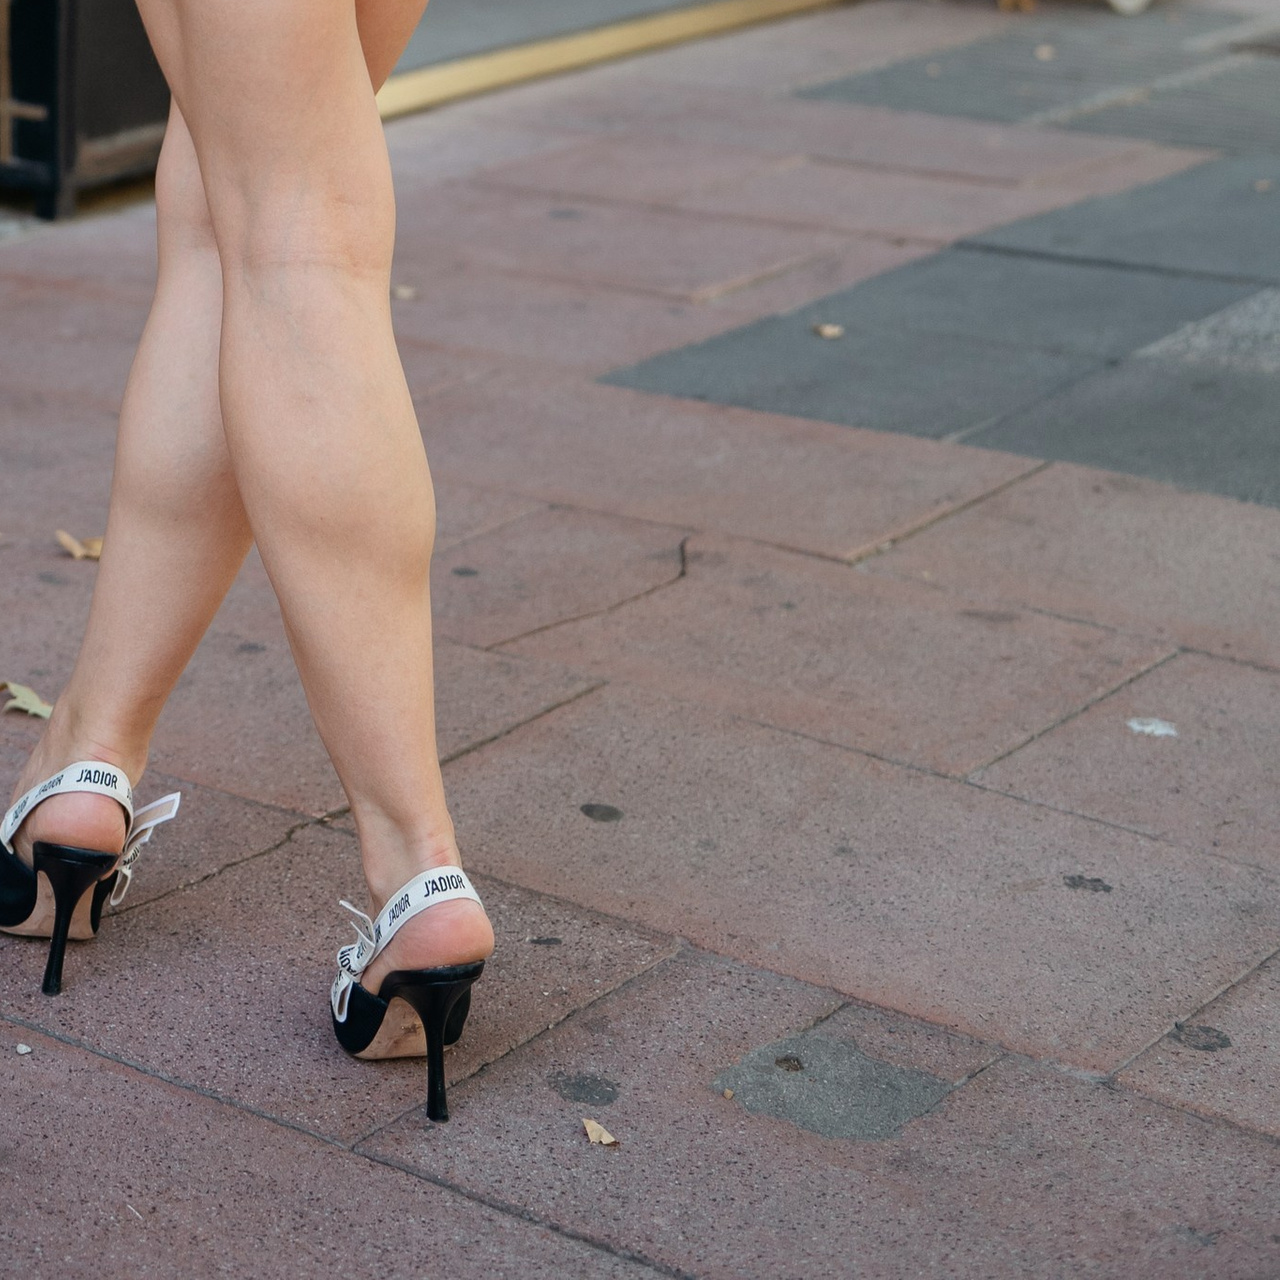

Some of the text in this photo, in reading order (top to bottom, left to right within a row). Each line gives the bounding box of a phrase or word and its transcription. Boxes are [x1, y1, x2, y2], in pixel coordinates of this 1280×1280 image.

[76, 769, 118, 790] J'ADIOR
[423, 874, 466, 898] J'ADIOR
[388, 893, 411, 927] J'ADIOR
